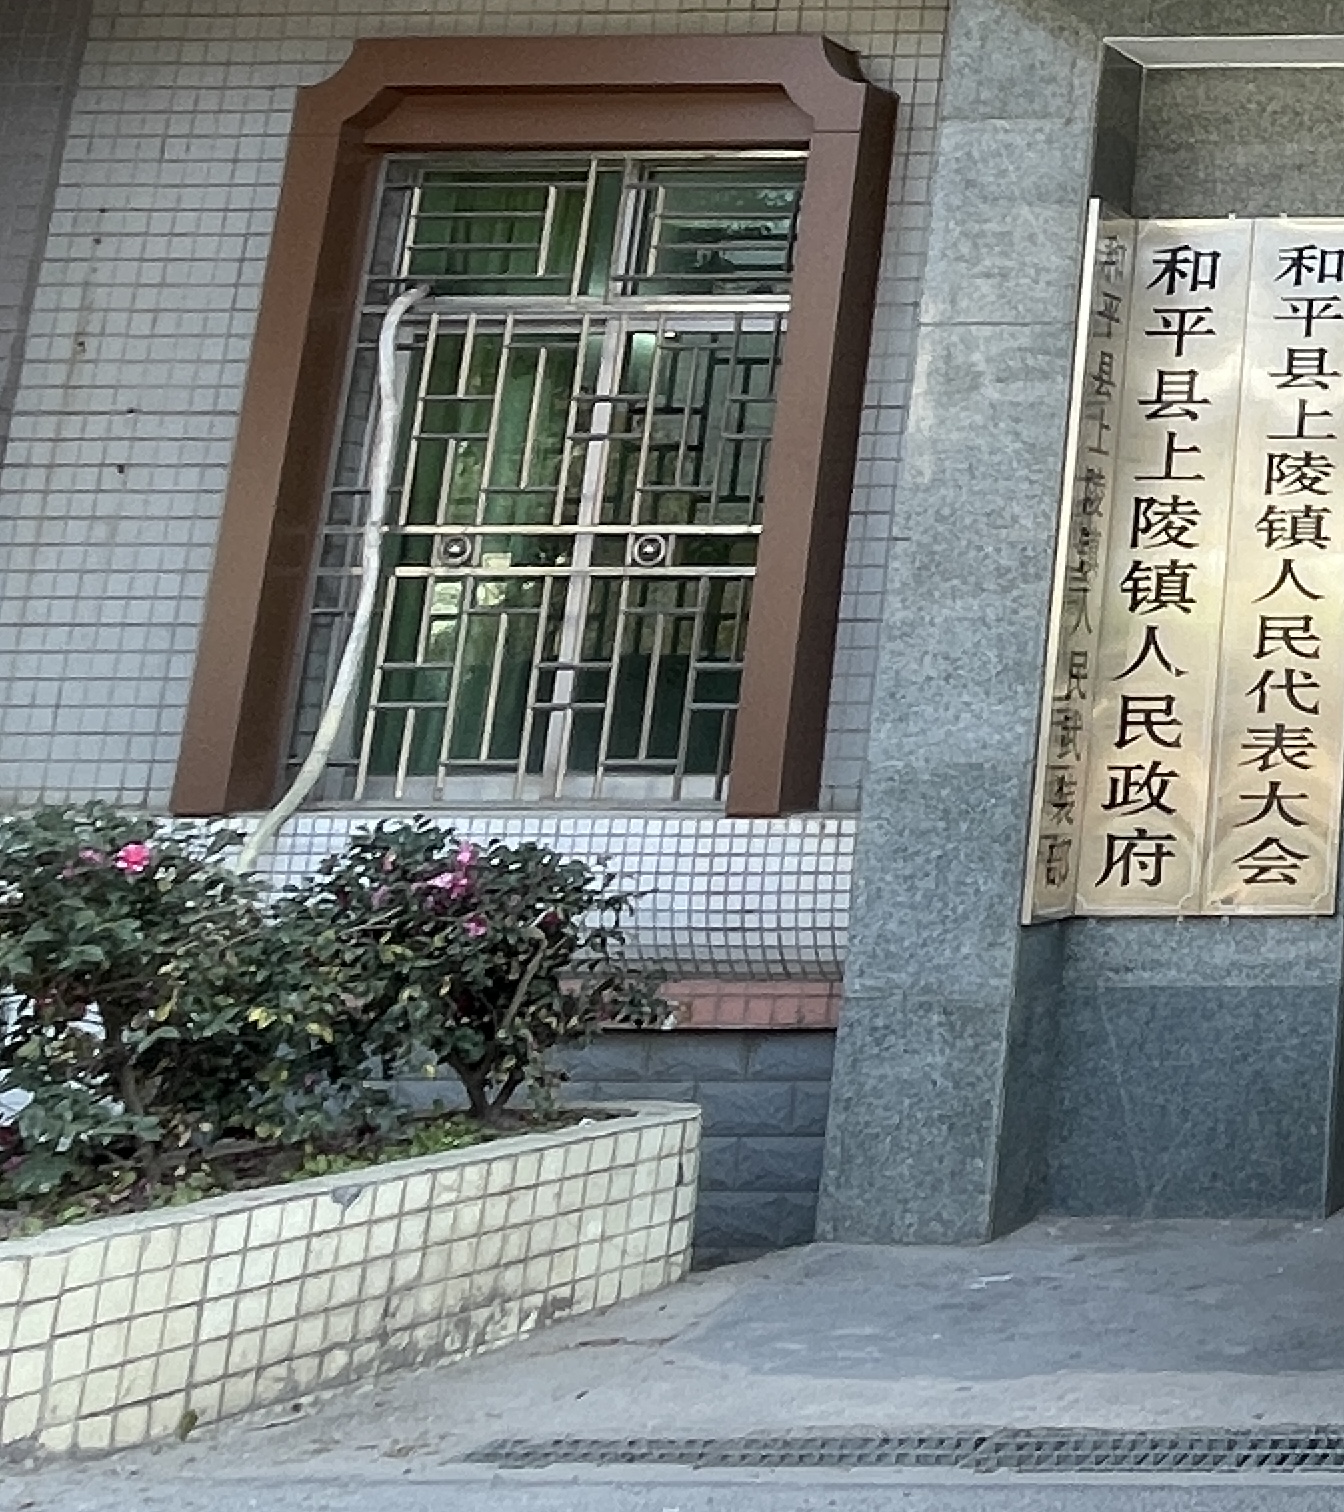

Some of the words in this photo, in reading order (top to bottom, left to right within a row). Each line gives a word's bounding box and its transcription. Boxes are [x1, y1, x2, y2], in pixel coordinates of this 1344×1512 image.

[1094, 243, 1223, 888] 和平县上陵镇人民政府
